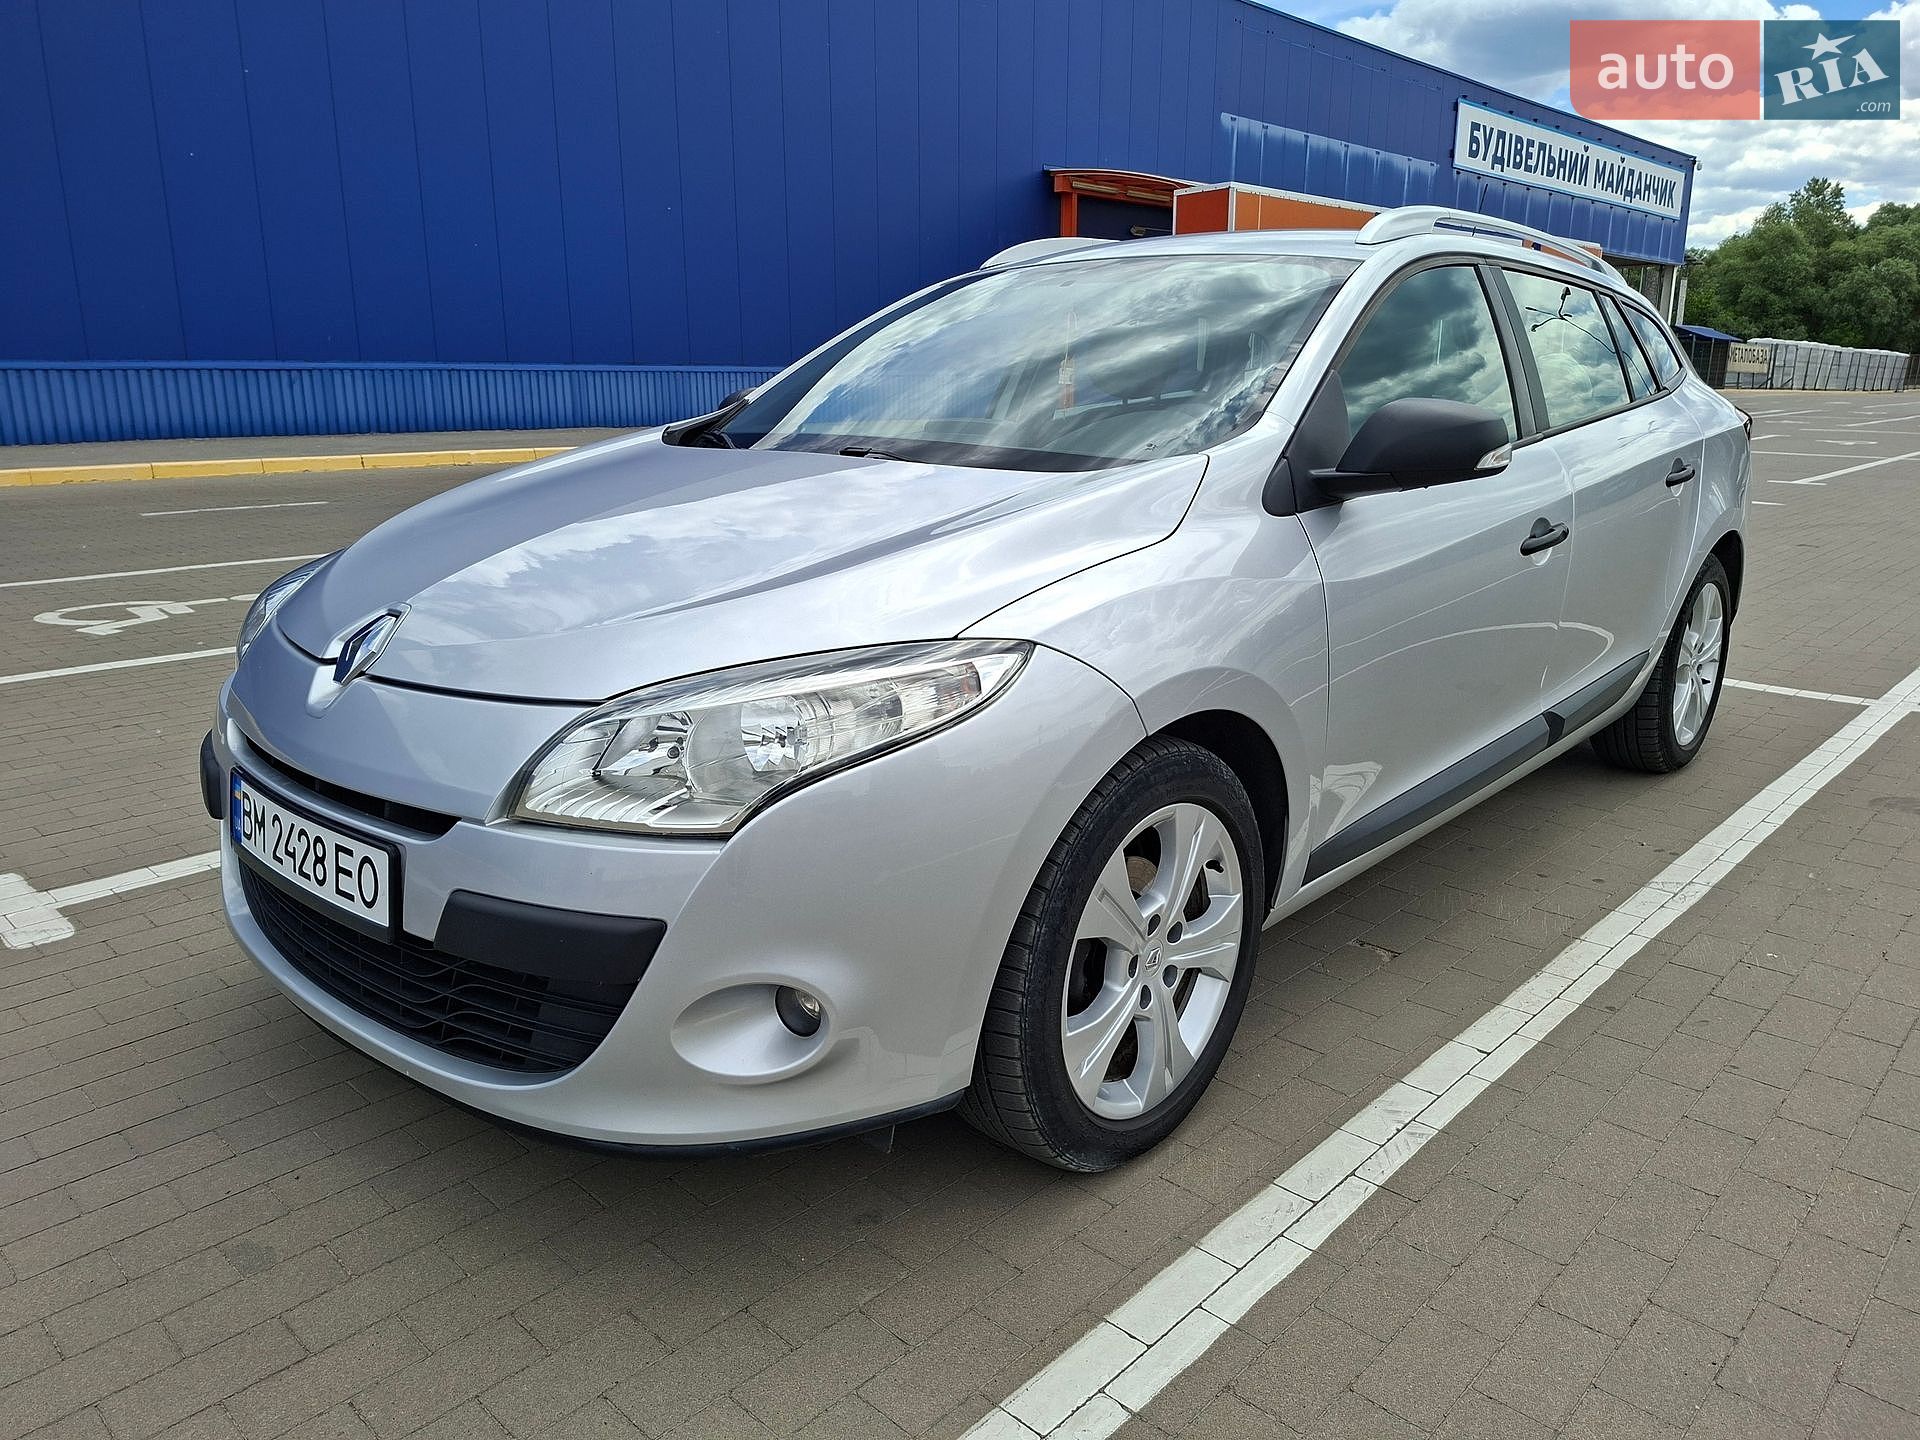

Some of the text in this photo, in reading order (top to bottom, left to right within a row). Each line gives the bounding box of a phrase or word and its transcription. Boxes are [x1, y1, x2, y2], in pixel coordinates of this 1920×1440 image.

[1468, 121, 1676, 209] БУДІВЕЛЬНИЙ МАЙДАНЧИК
[241, 790, 379, 909] BM 2428 EO
